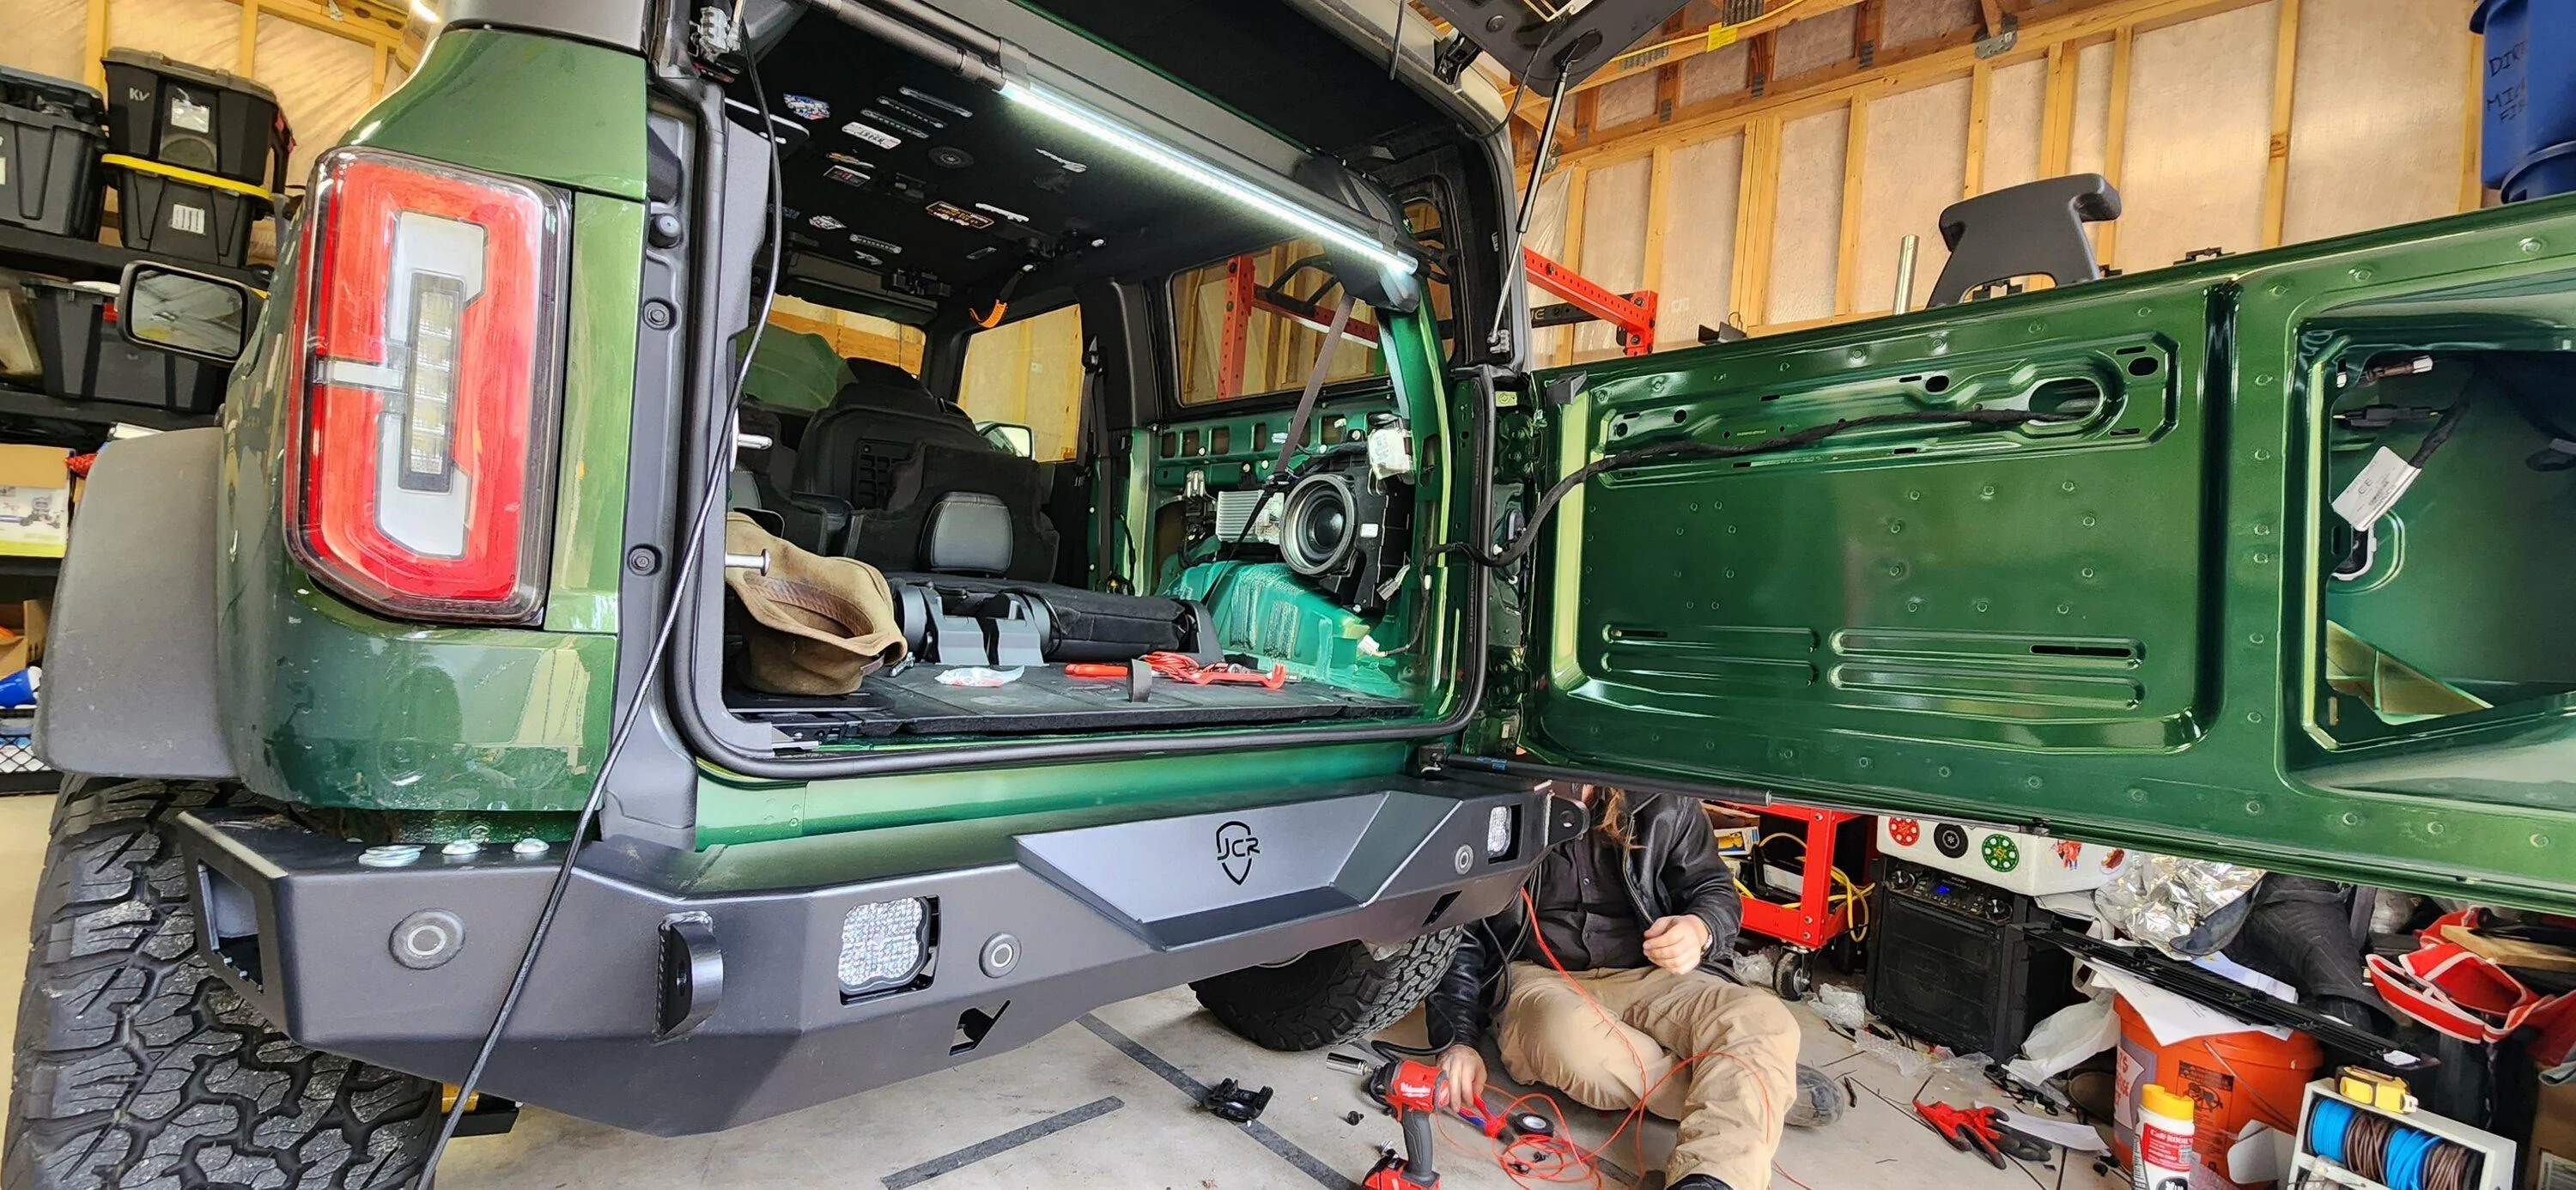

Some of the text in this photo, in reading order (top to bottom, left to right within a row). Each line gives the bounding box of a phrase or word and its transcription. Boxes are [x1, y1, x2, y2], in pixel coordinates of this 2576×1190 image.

[129, 87, 150, 101] KV
[2358, 478, 2374, 495] CE
[1217, 837, 1261, 860] JCR
